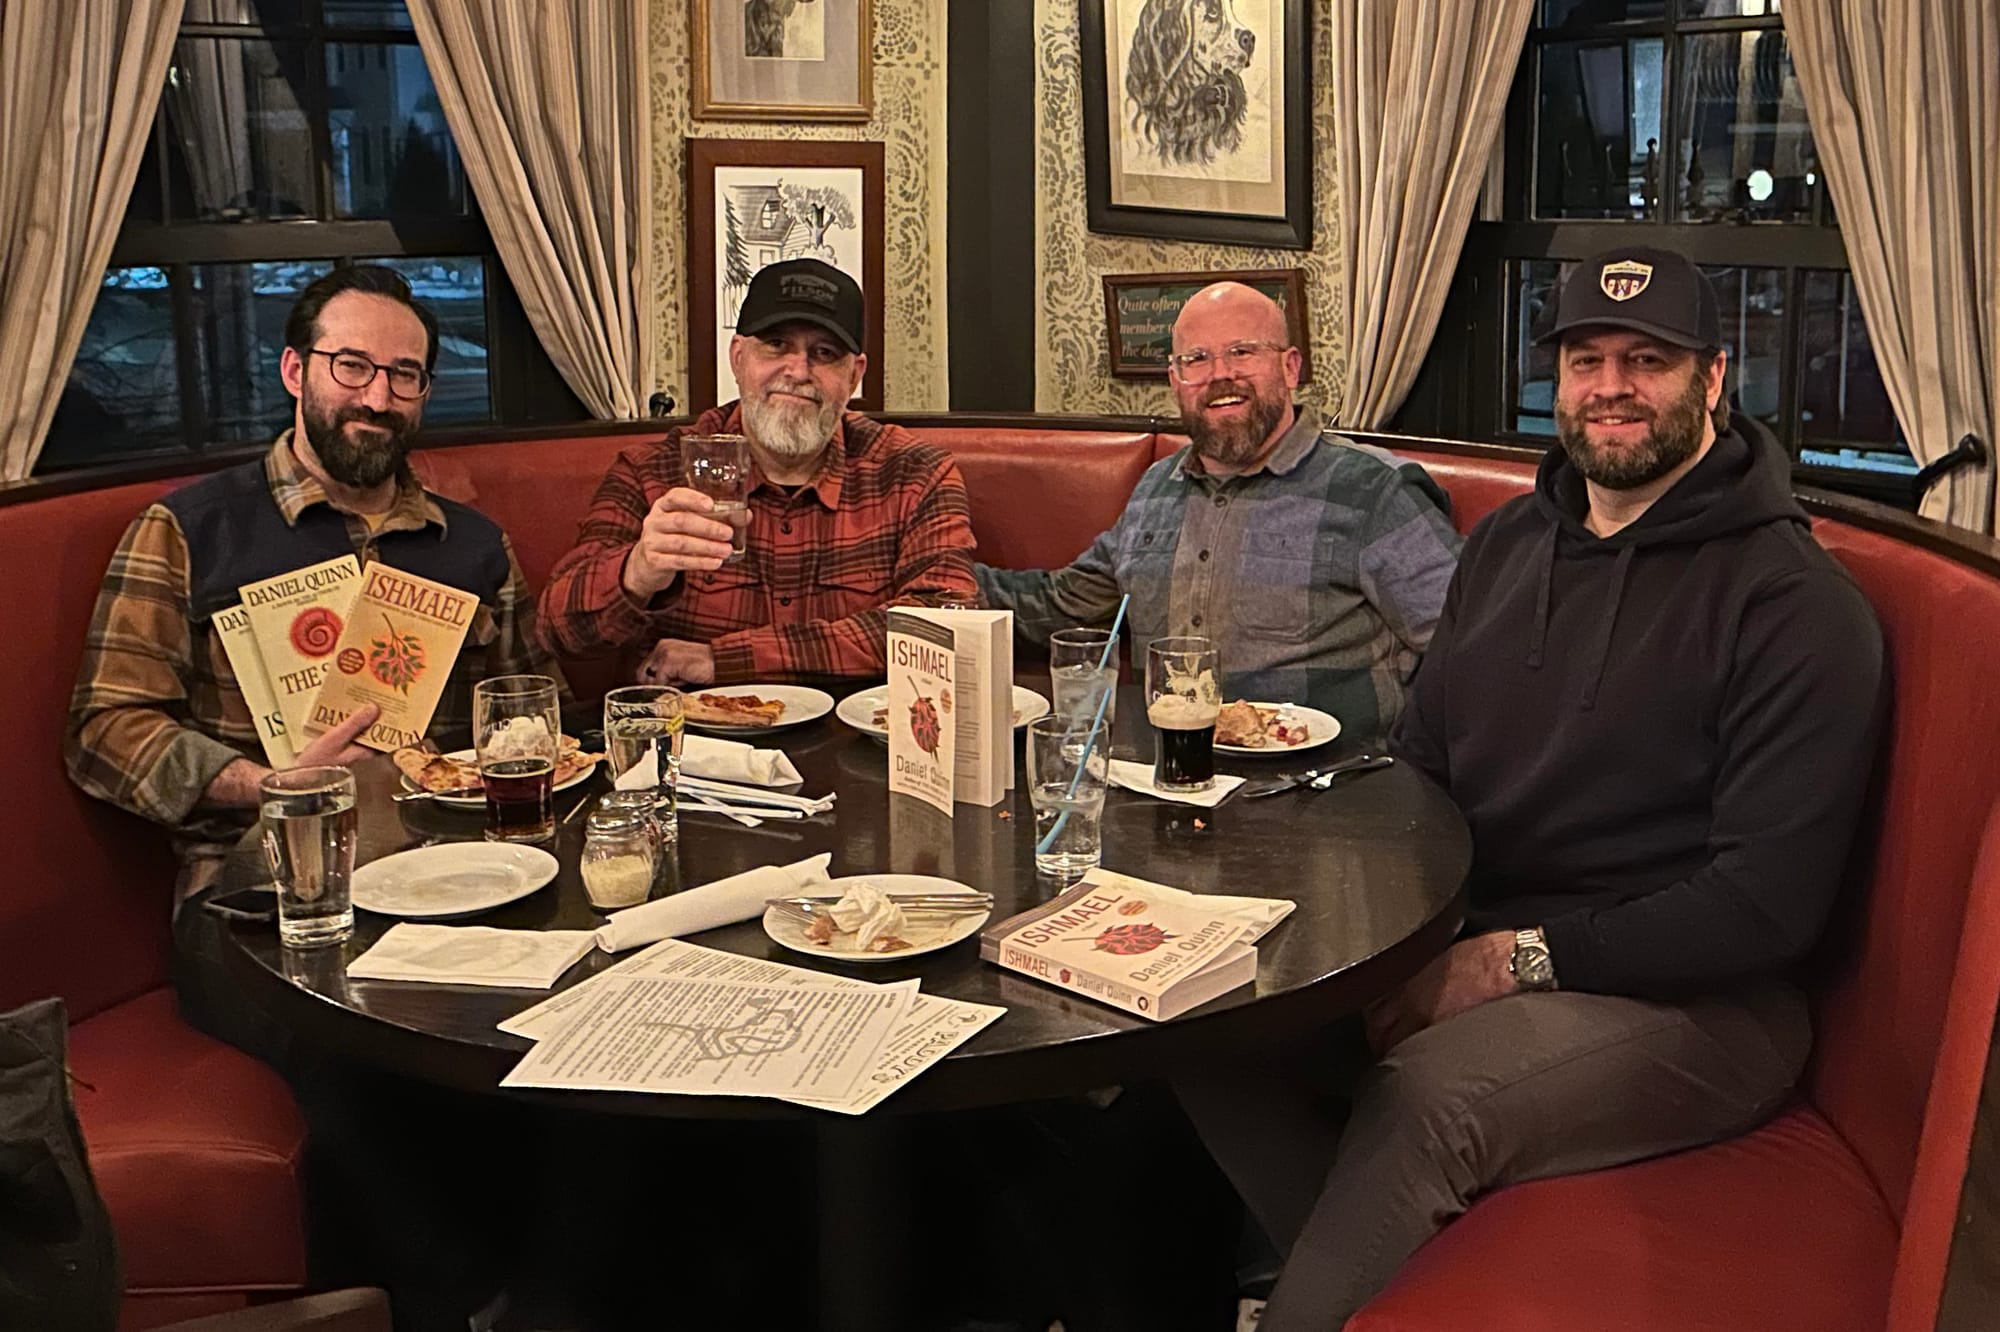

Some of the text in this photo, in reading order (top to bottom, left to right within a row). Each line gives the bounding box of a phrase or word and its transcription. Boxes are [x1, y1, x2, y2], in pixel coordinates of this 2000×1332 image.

[1118, 296, 1149, 315] Quite
[1151, 295, 1180, 315] often
[1120, 318, 1165, 334] member
[1122, 341, 1165, 360] the dog
[247, 574, 305, 607] DANIEL
[305, 562, 355, 591] QUINN
[364, 572, 466, 626] ISHMAEL
[219, 609, 249, 632] DAN
[892, 639, 952, 684] ISHMAEL
[280, 666, 322, 695] THE
[896, 754, 927, 780] Daniel
[1012, 895, 1124, 948] ISHMAEL
[1129, 952, 1182, 982] Daniel
[1178, 920, 1225, 951] Quinn
[1005, 949, 1051, 979] ISHMAEL
[1076, 974, 1104, 994] Daniel
